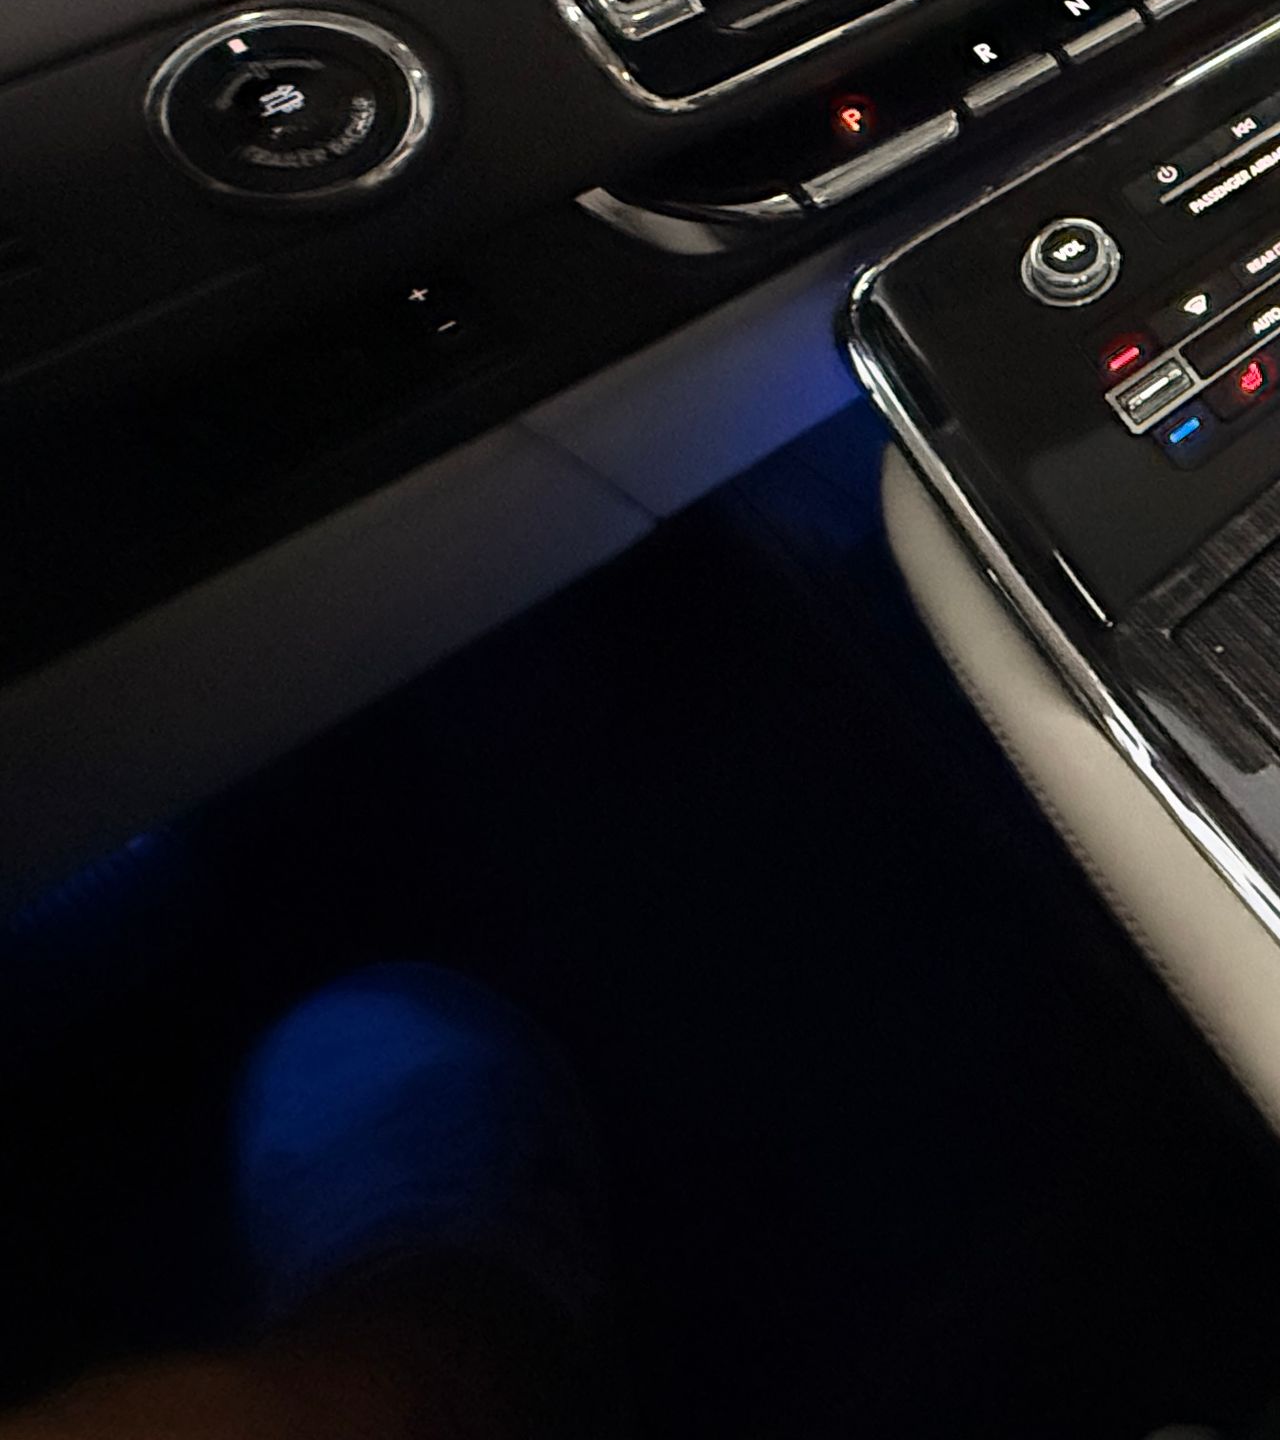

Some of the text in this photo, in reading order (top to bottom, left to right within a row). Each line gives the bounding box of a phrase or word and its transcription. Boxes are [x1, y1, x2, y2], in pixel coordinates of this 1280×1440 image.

[973, 42, 998, 64] R
[841, 106, 862, 132] P
[1188, 169, 1252, 214] PASSENGER
[1053, 240, 1086, 261] VOL
